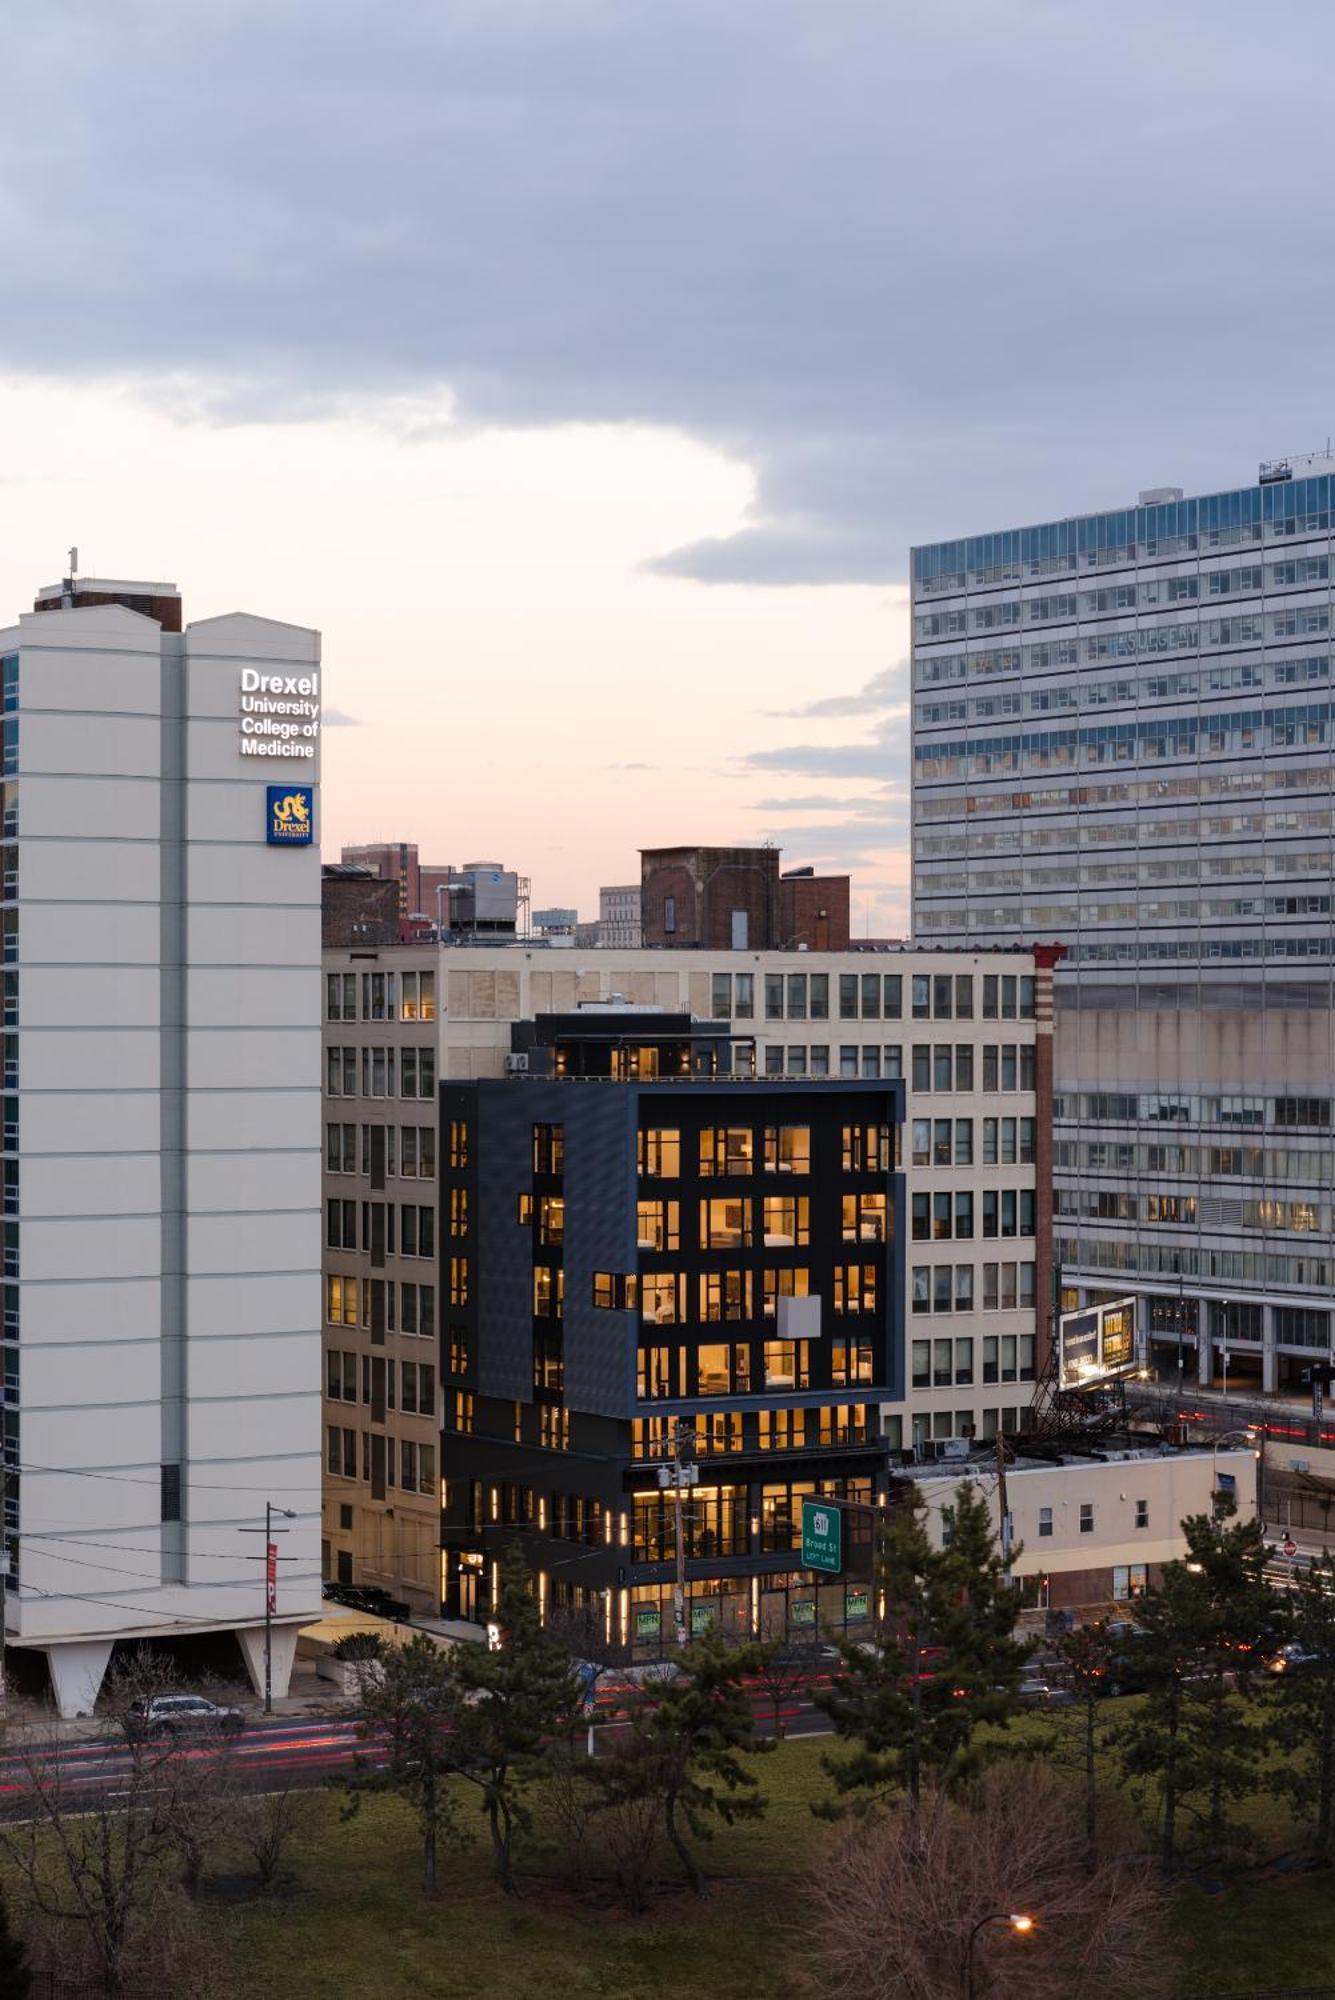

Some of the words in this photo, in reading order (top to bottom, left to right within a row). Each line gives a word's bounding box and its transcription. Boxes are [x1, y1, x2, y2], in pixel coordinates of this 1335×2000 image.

[242, 669, 318, 695] Drexel
[242, 696, 319, 719] University
[242, 717, 299, 739] College
[303, 721, 319, 736] of
[242, 739, 314, 757] Medicine
[274, 820, 309, 832] Drexel
[815, 1518, 827, 1530] 611
